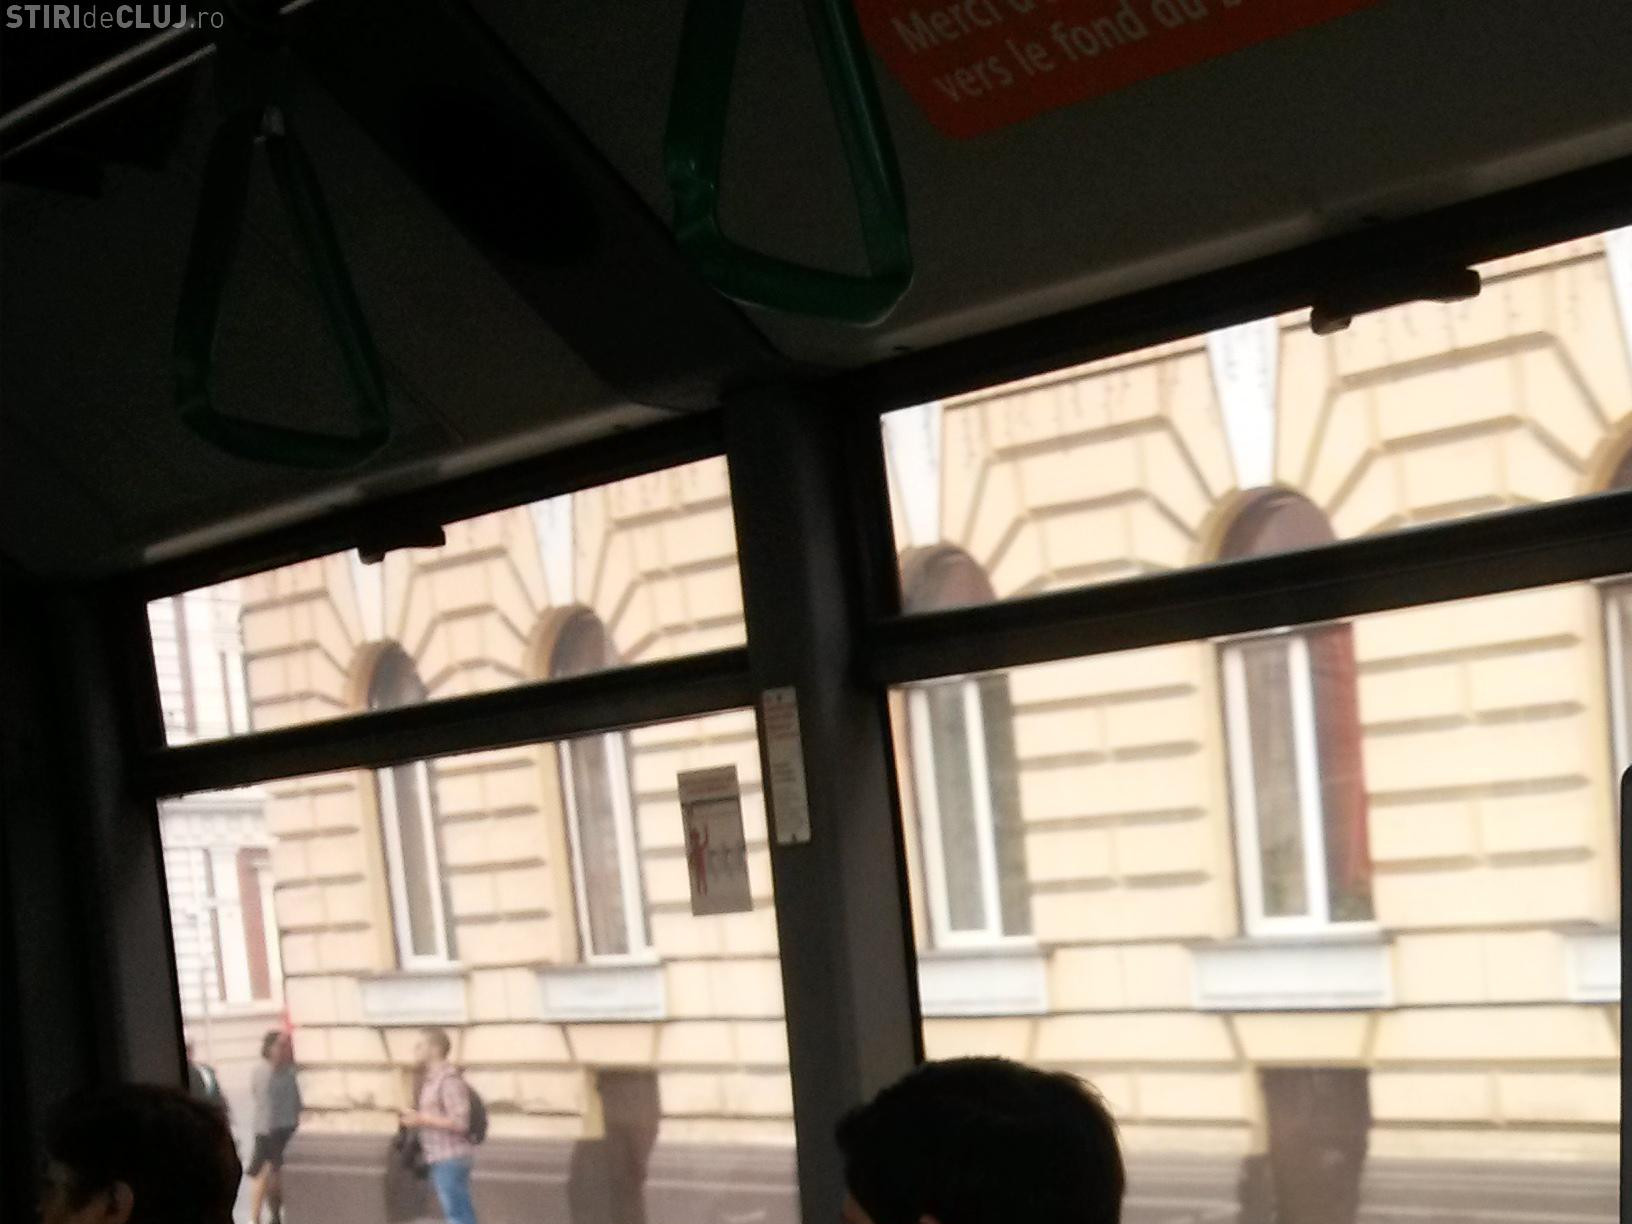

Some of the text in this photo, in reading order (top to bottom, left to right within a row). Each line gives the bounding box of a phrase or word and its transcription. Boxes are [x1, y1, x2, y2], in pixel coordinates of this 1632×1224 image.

[932, 54, 1014, 103] vers
[1005, 37, 1056, 77] le
[1048, 0, 1149, 61] fond
